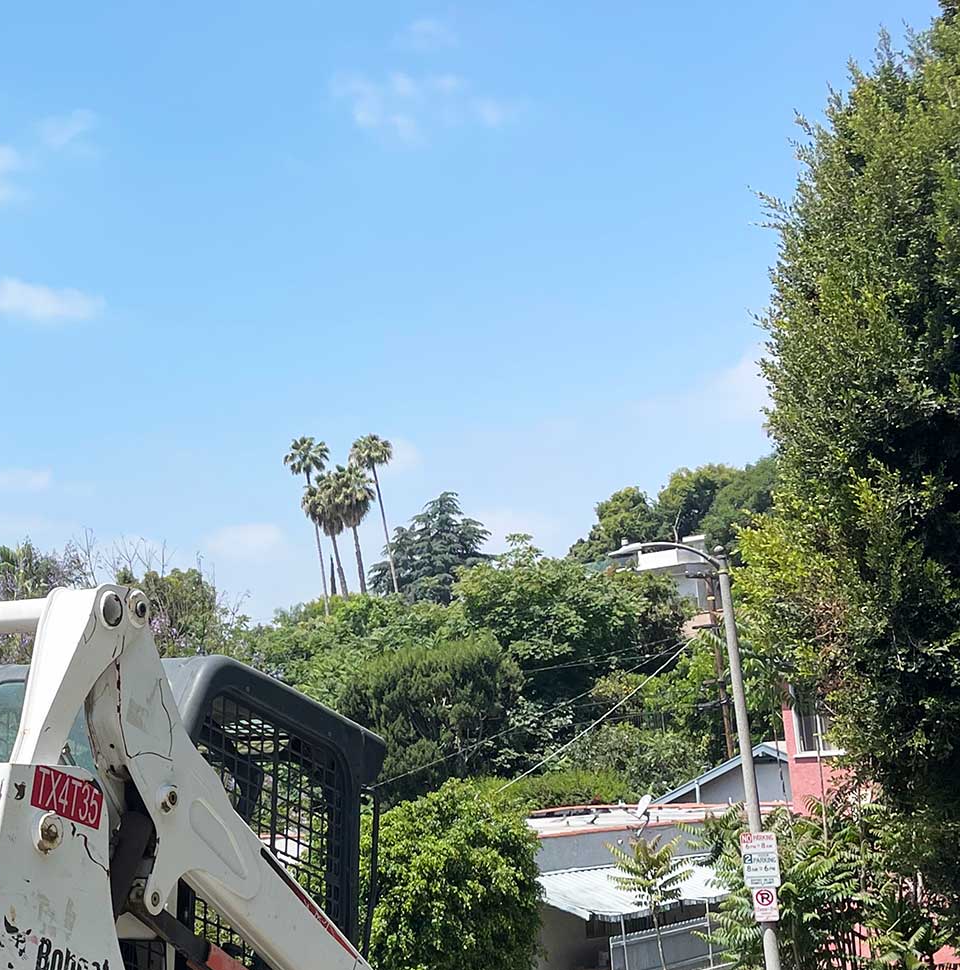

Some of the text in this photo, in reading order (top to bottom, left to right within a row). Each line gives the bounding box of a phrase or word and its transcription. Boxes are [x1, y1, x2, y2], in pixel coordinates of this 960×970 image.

[38, 767, 100, 825] TX4T35
[740, 832, 752, 843] NO
[743, 854, 752, 864] 2
